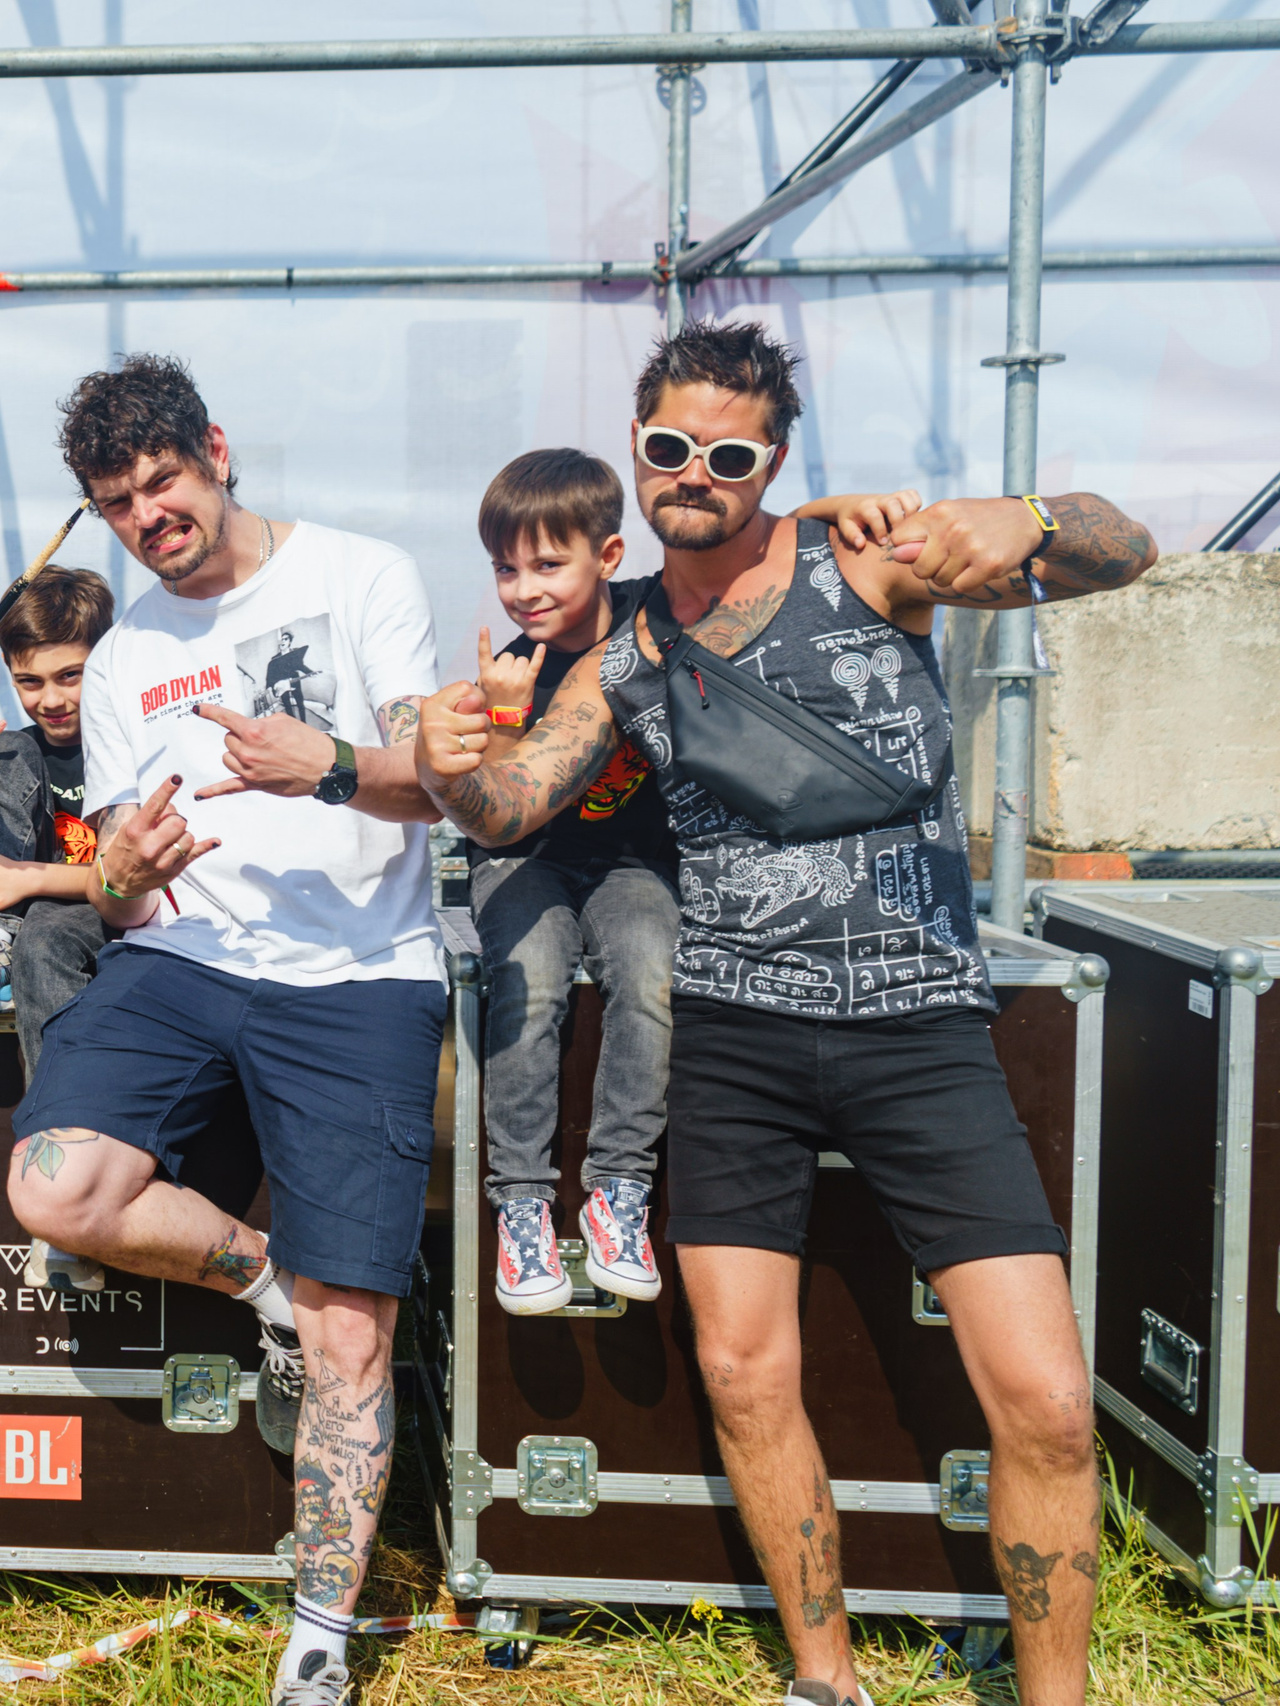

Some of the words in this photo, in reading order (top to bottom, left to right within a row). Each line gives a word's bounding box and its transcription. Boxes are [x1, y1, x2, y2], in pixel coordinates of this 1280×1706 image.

[140, 682, 169, 716] BOB
[169, 664, 222, 702] DYLAN
[160, 705, 182, 717] times
[208, 693, 222, 701] are
[16, 1287, 143, 1313] EVENTS
[332, 1396, 340, 1409] Я
[325, 1407, 361, 1422] ВИДЕЛ
[325, 1421, 345, 1433] ЕГО
